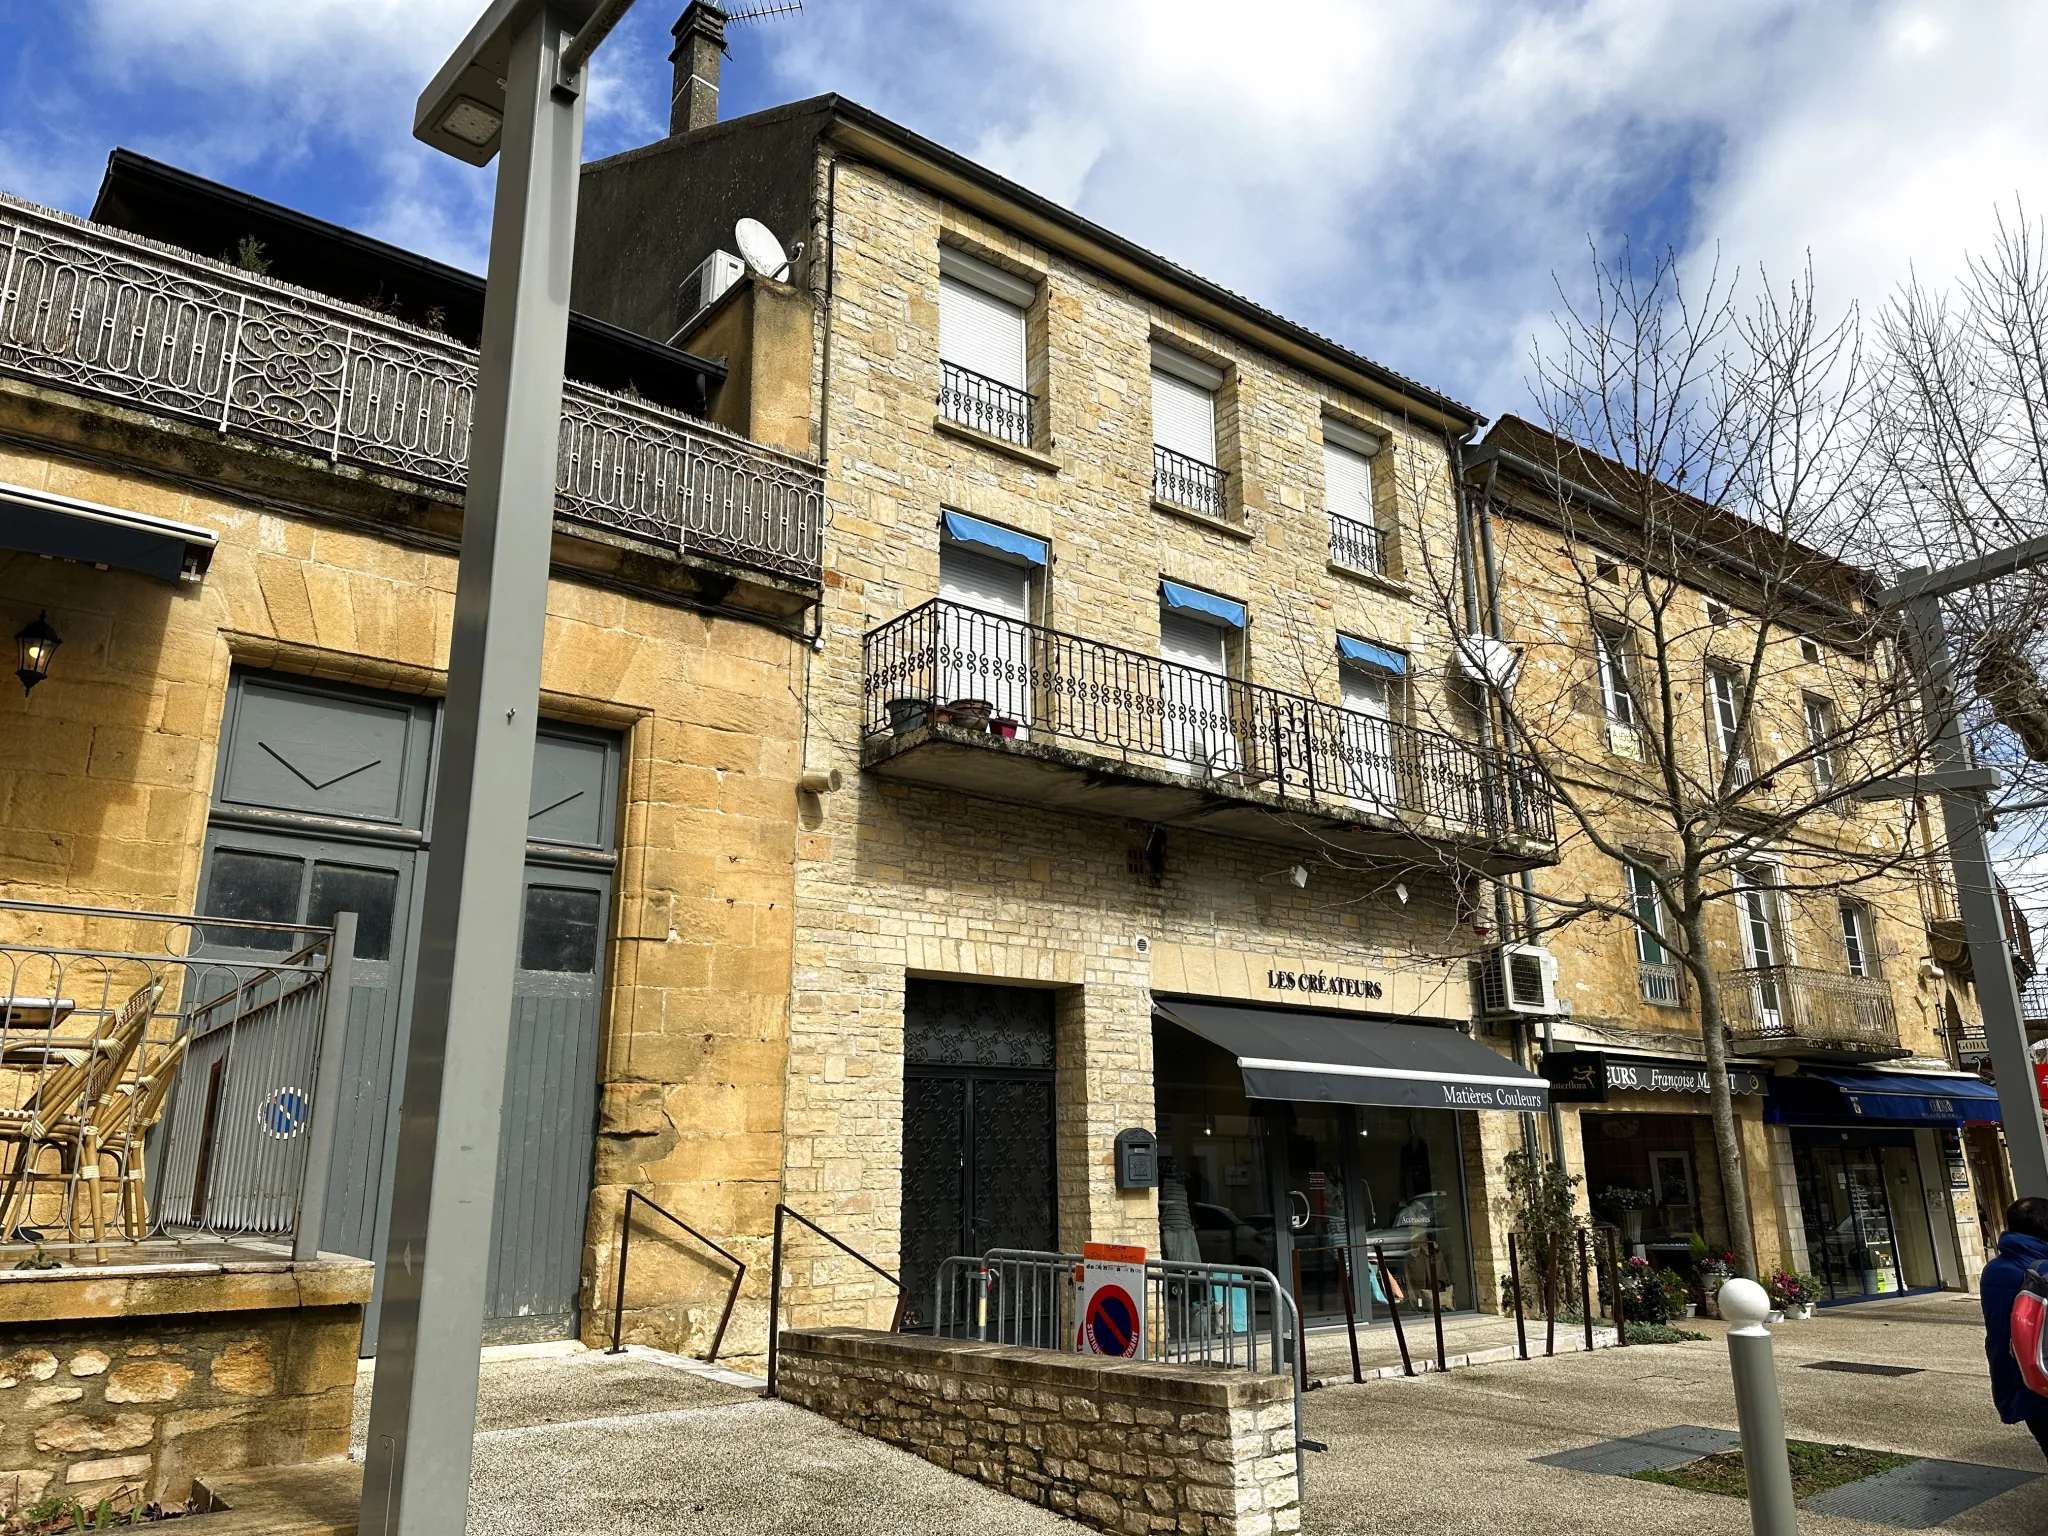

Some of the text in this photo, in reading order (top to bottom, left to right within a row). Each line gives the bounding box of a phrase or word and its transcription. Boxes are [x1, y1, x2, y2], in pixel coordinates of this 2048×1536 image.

[1267, 969, 1383, 1000] LES CRÉATEURS
[1957, 1040, 1988, 1051] GODA
[1650, 1069, 1695, 1090] Françoise
[1442, 1085, 1541, 1107] Matières Couleurs
